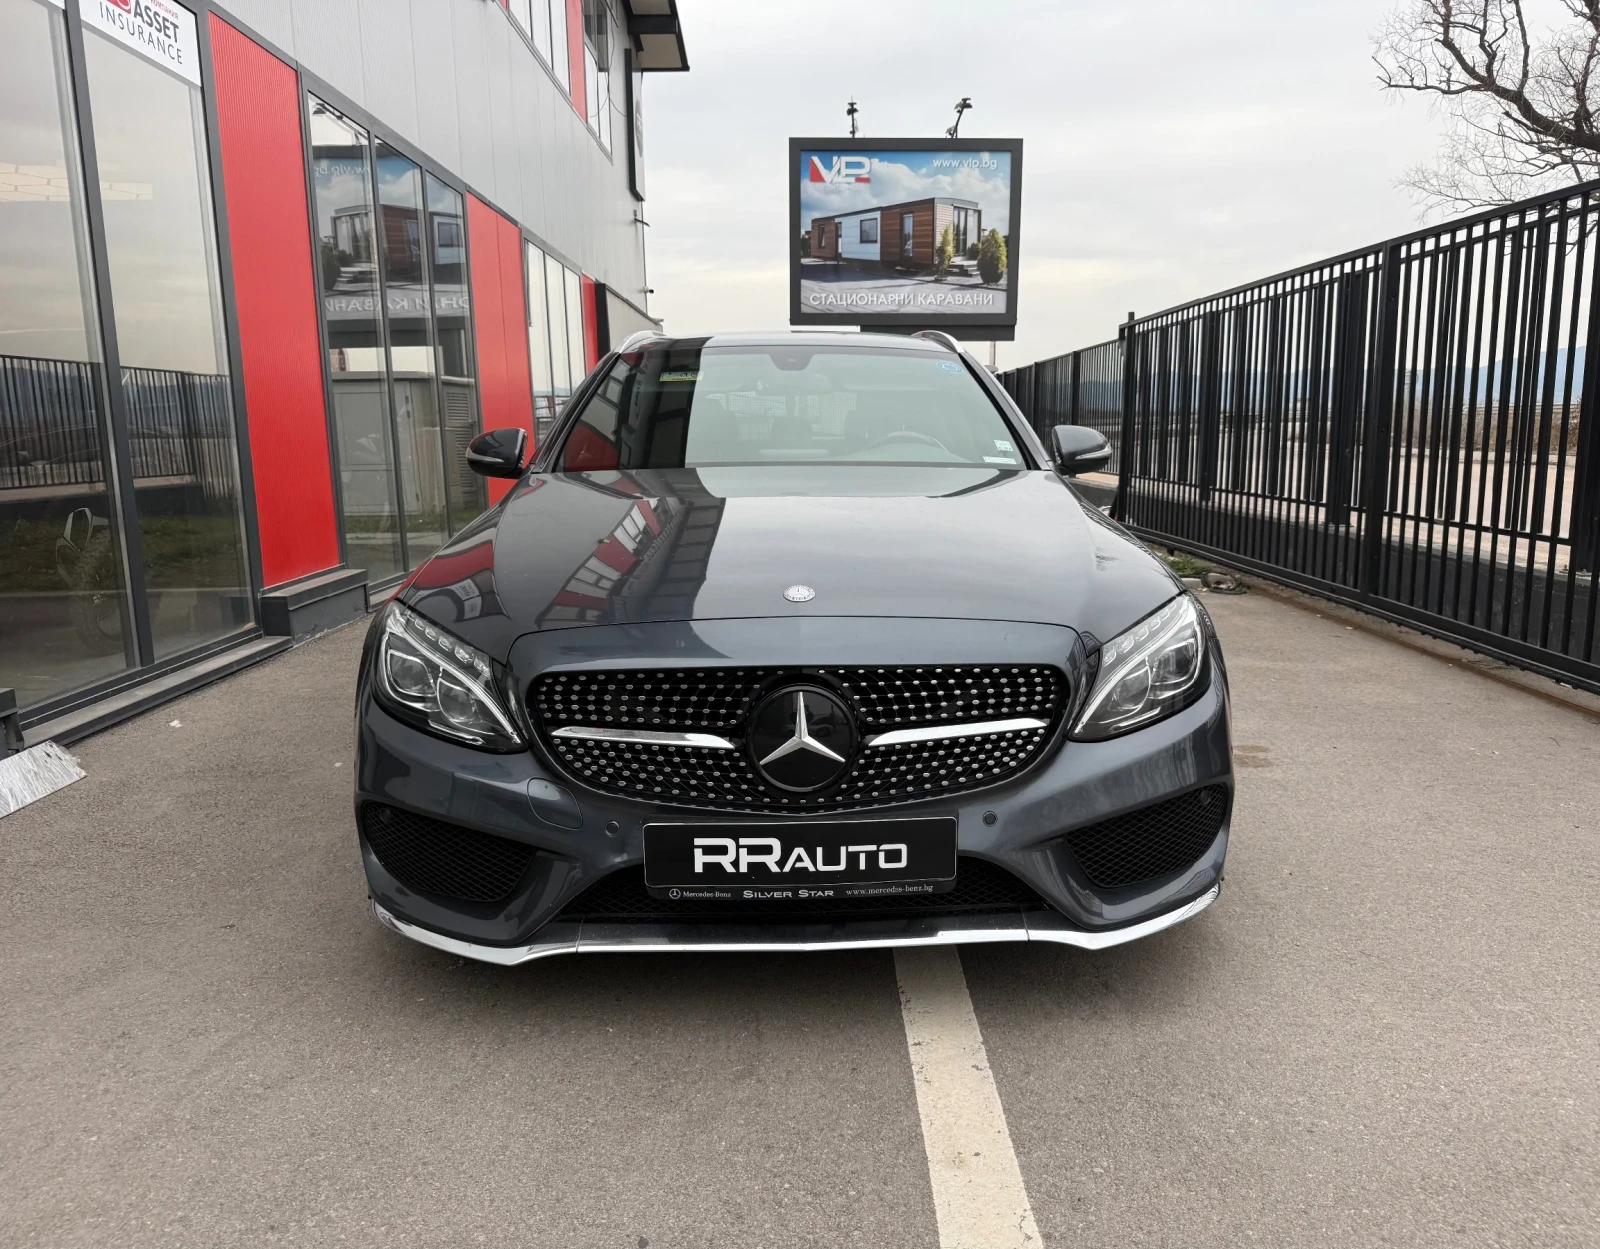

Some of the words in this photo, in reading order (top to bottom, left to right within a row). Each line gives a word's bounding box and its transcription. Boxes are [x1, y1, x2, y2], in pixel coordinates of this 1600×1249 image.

[134, 0, 179, 43] ASSET
[99, 2, 183, 65] INSURANCE
[933, 157, 998, 170] www.vlp.bg
[809, 292, 914, 307] СТАЦИОНАРНИ
[917, 293, 994, 306] КАРАВАНИ
[682, 890, 732, 899] Mercedes-Benz
